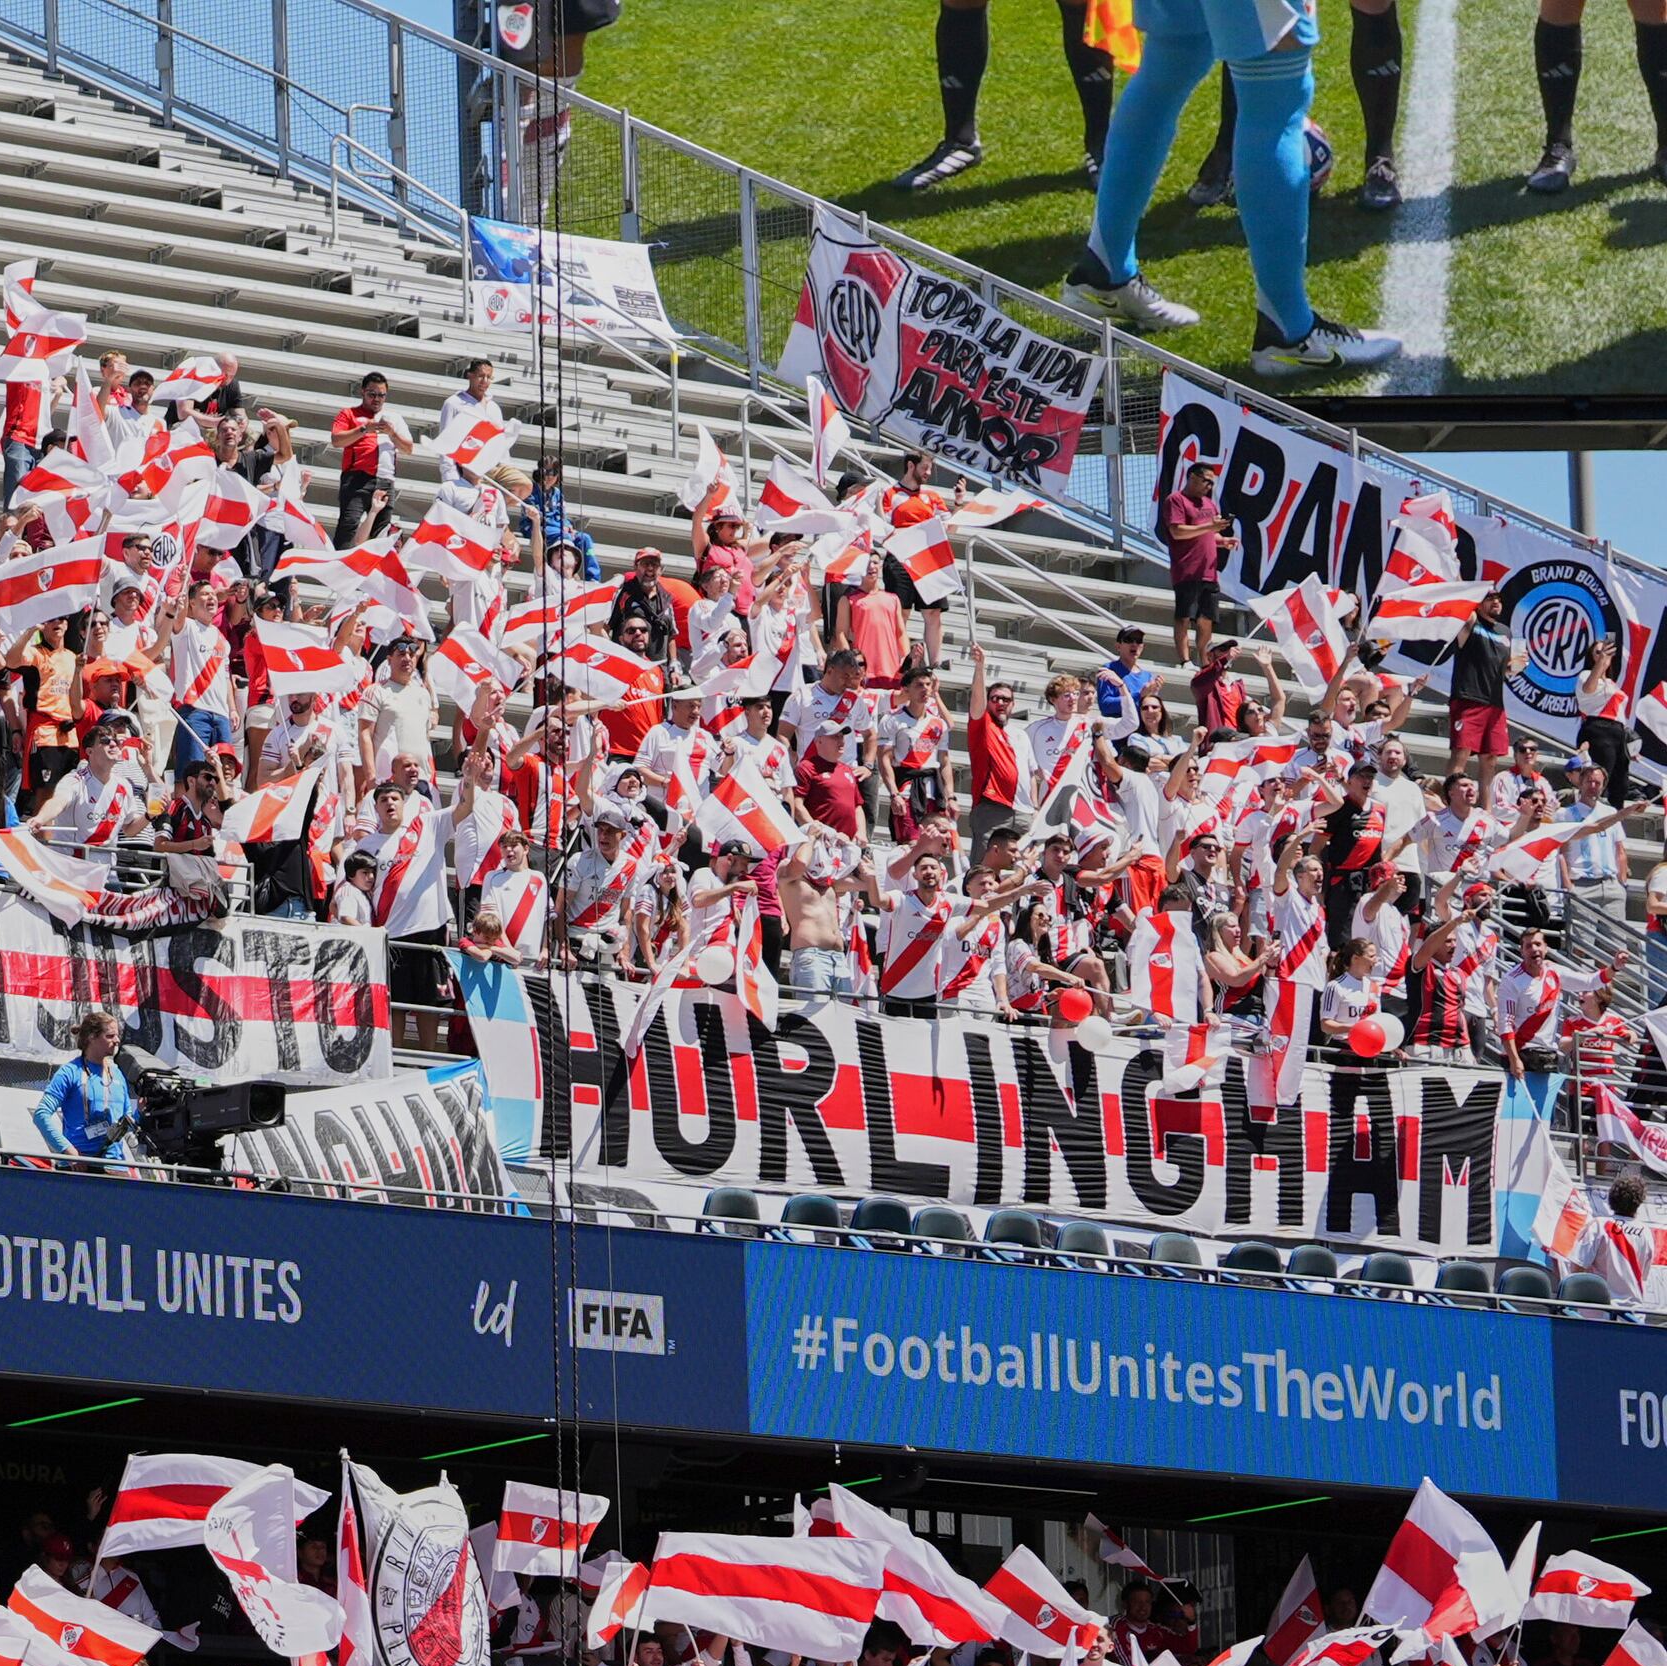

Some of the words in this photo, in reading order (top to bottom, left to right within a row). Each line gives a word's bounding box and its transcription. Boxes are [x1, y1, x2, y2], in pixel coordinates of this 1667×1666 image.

[910, 272, 988, 332] TODA
[982, 317, 1022, 361] LA
[1016, 339, 1093, 399] VIDA
[918, 329, 987, 390] PARA
[983, 366, 1053, 424] ESTE
[893, 368, 1060, 484] AMOR
[1530, 564, 1573, 585] GRAND
[533, 974, 1505, 1246] HURLINGHAM
[1612, 1219, 1644, 1239] Bud
[154, 1247, 303, 1326] UNITES
[471, 1279, 519, 1349] ld
[581, 1301, 654, 1341] FIFA
[791, 1312, 1502, 1436] #FootballUnitesTheWorld
